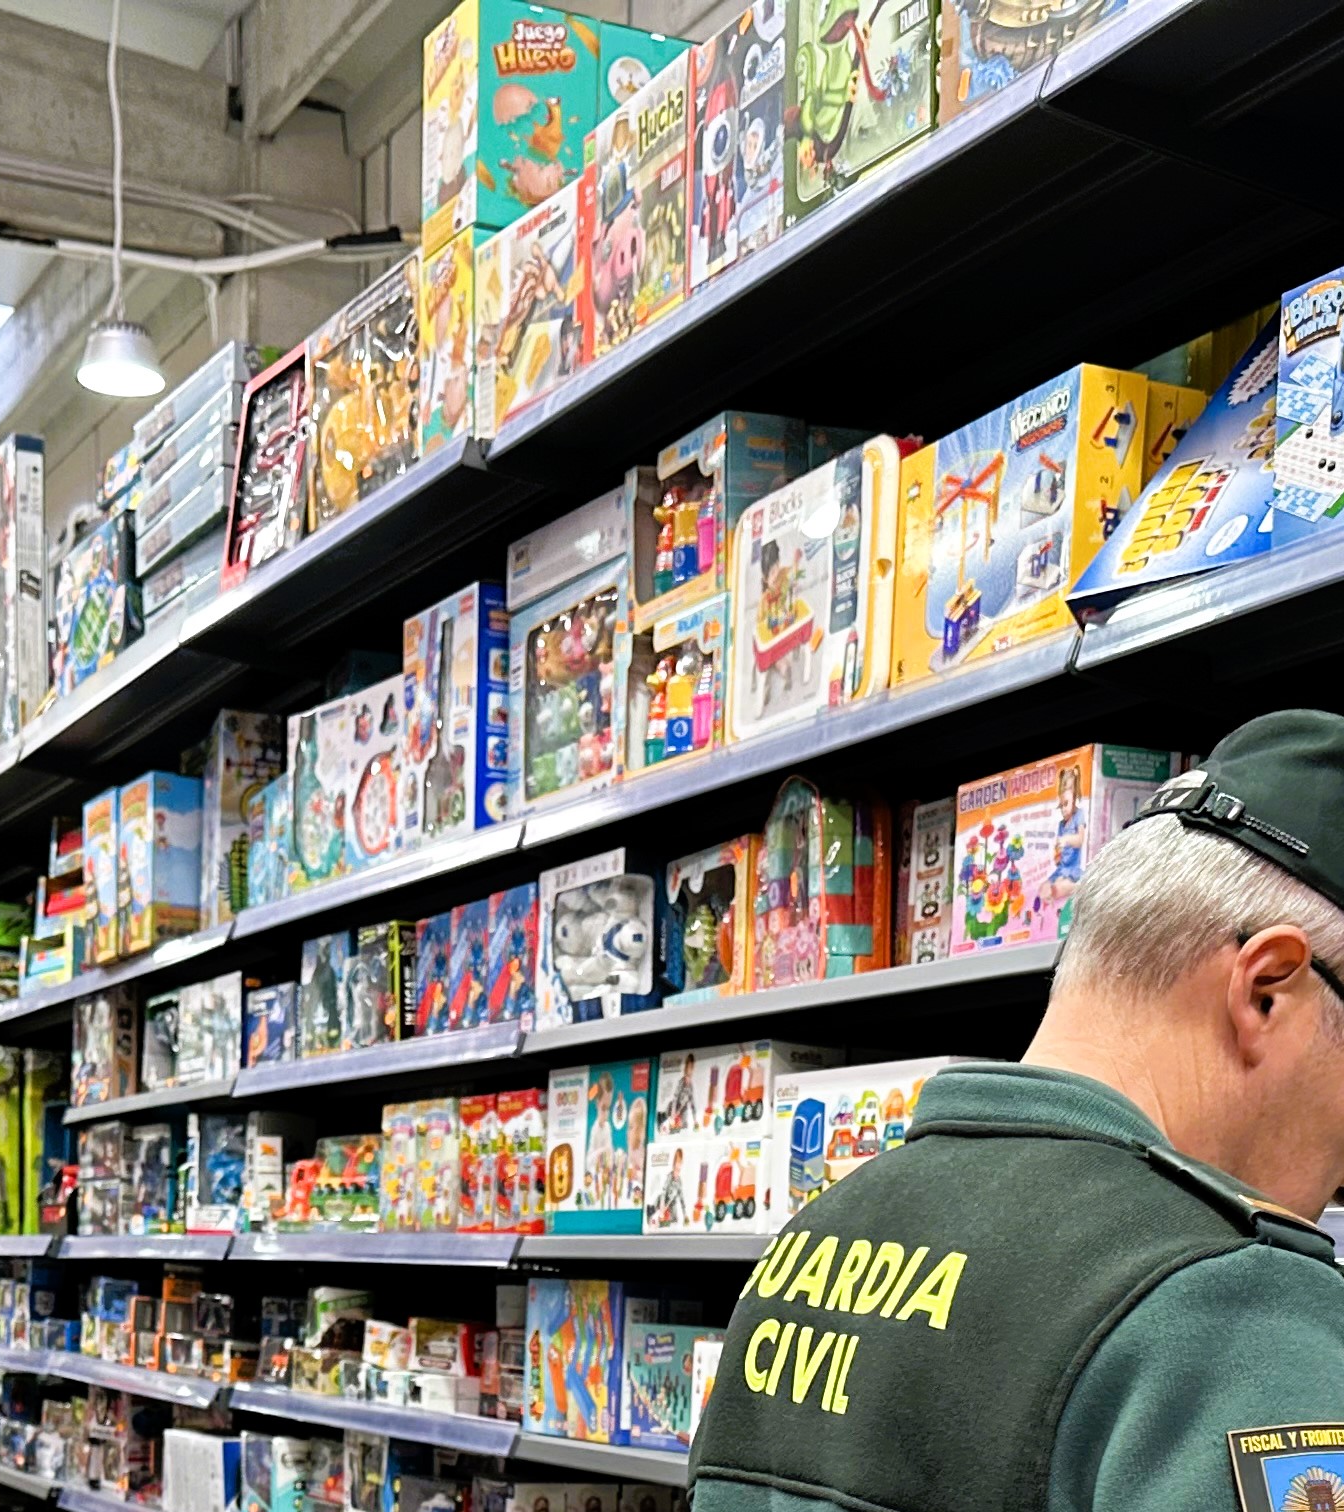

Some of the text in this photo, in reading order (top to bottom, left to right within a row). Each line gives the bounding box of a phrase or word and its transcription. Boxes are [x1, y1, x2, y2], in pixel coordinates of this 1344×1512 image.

[512, 22, 567, 43] Juego
[494, 44, 577, 76] Huevo
[637, 88, 684, 157] Hucha
[959, 765, 1057, 813] GARDEN WORLD
[744, 1318, 860, 1415] CIVIL
[1240, 1433, 1287, 1453] FISCAL
[1287, 1431, 1299, 1448] Y
